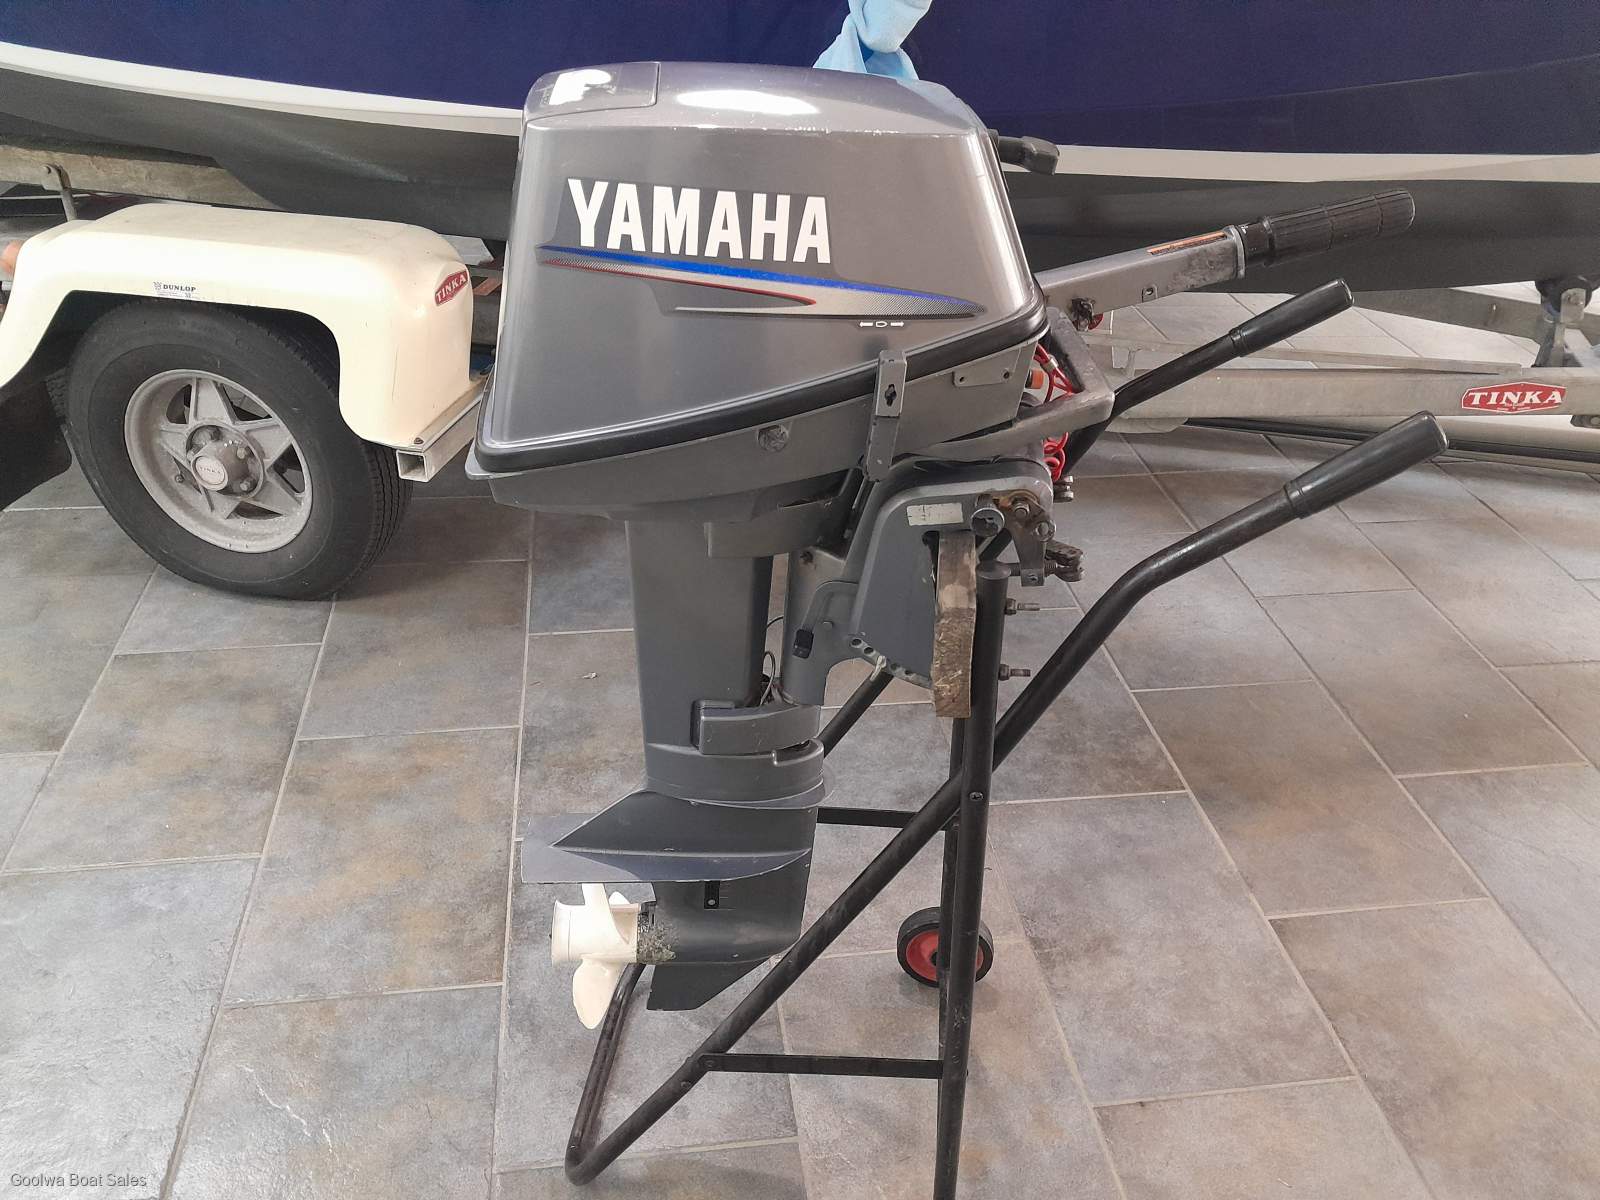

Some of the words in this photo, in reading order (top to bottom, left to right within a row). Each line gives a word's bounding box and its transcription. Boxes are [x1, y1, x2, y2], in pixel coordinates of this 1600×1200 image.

[567, 178, 831, 264] YAMAHA
[163, 284, 196, 292] DUNLOP
[436, 274, 466, 302] TINKA
[1468, 391, 1562, 405] TINKA
